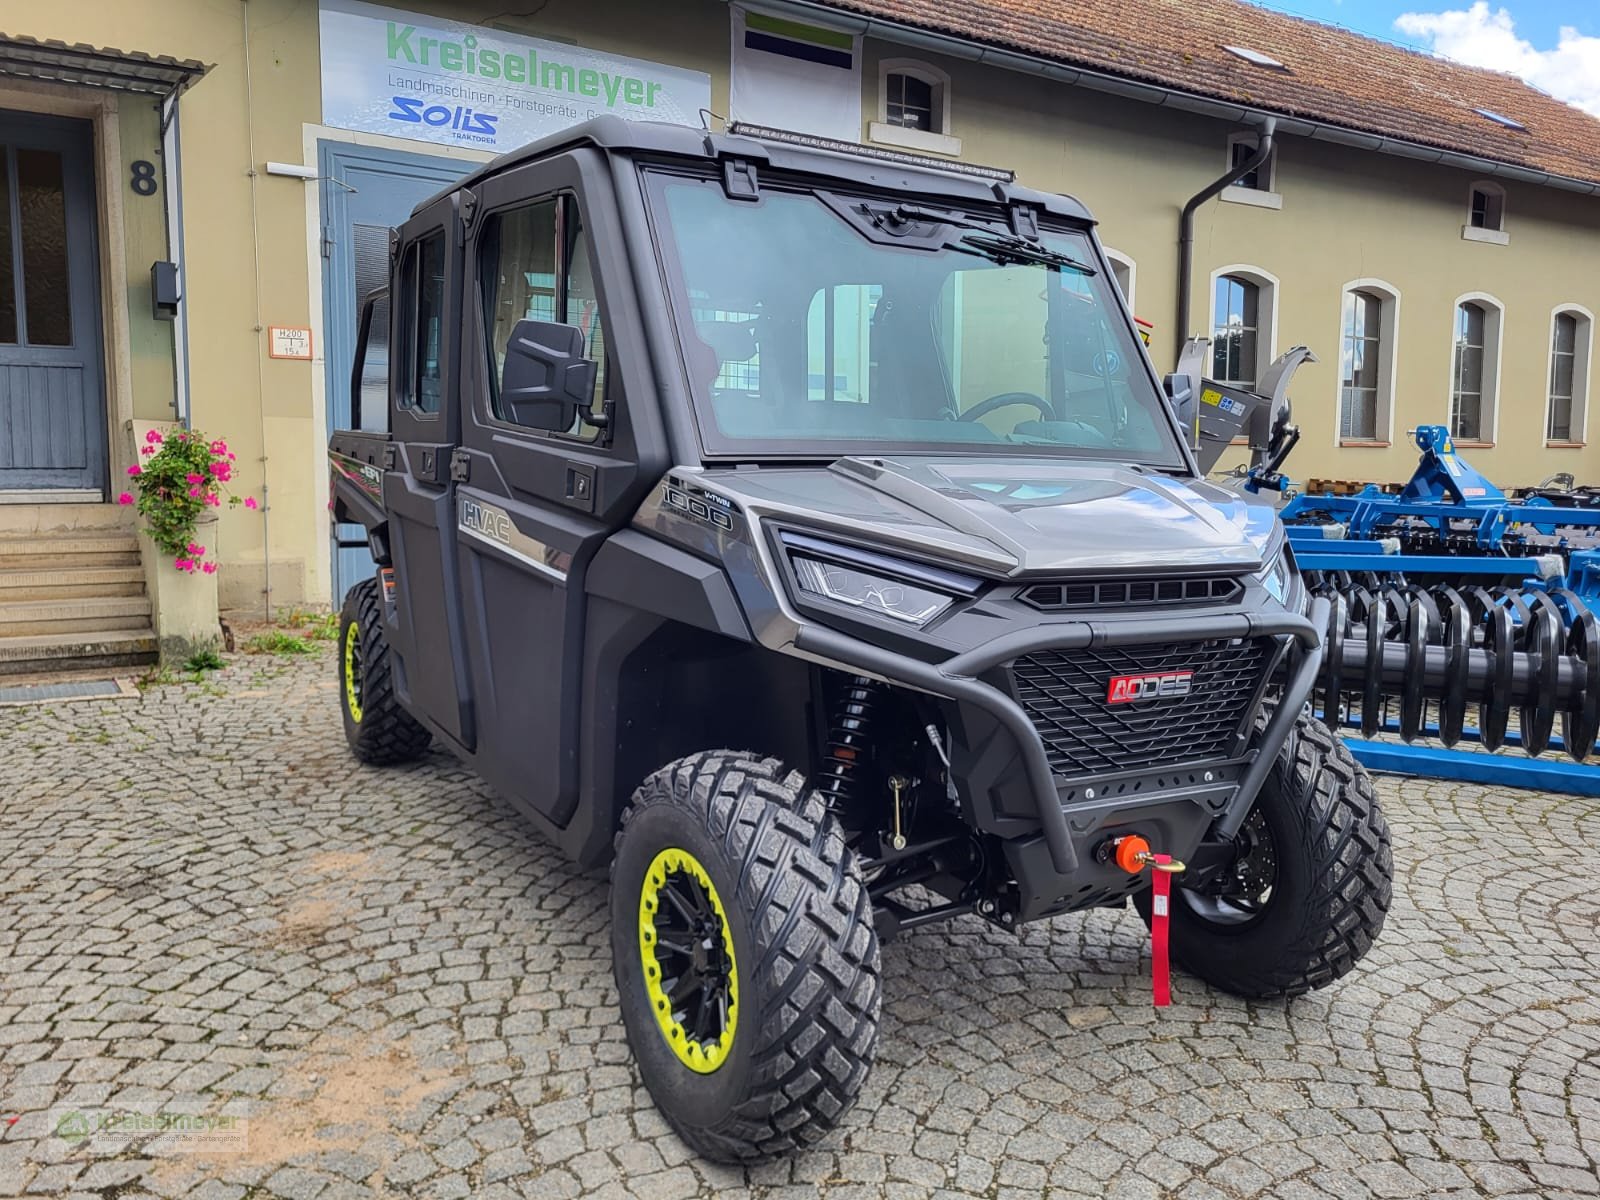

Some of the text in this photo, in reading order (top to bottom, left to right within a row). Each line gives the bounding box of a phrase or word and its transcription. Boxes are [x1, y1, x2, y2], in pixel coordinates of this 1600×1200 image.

[386, 21, 662, 108] Kreiselmeyer
[388, 72, 495, 104] Landmaschinen
[505, 95, 577, 119] Forstgeräte
[452, 132, 496, 144] TRAKTOREN
[131, 160, 157, 196] 8
[279, 329, 302, 338] H200
[661, 484, 734, 532] 1000
[703, 490, 731, 508] V-TWIN
[463, 500, 510, 544] HVAC
[1111, 674, 1192, 701] AODES
